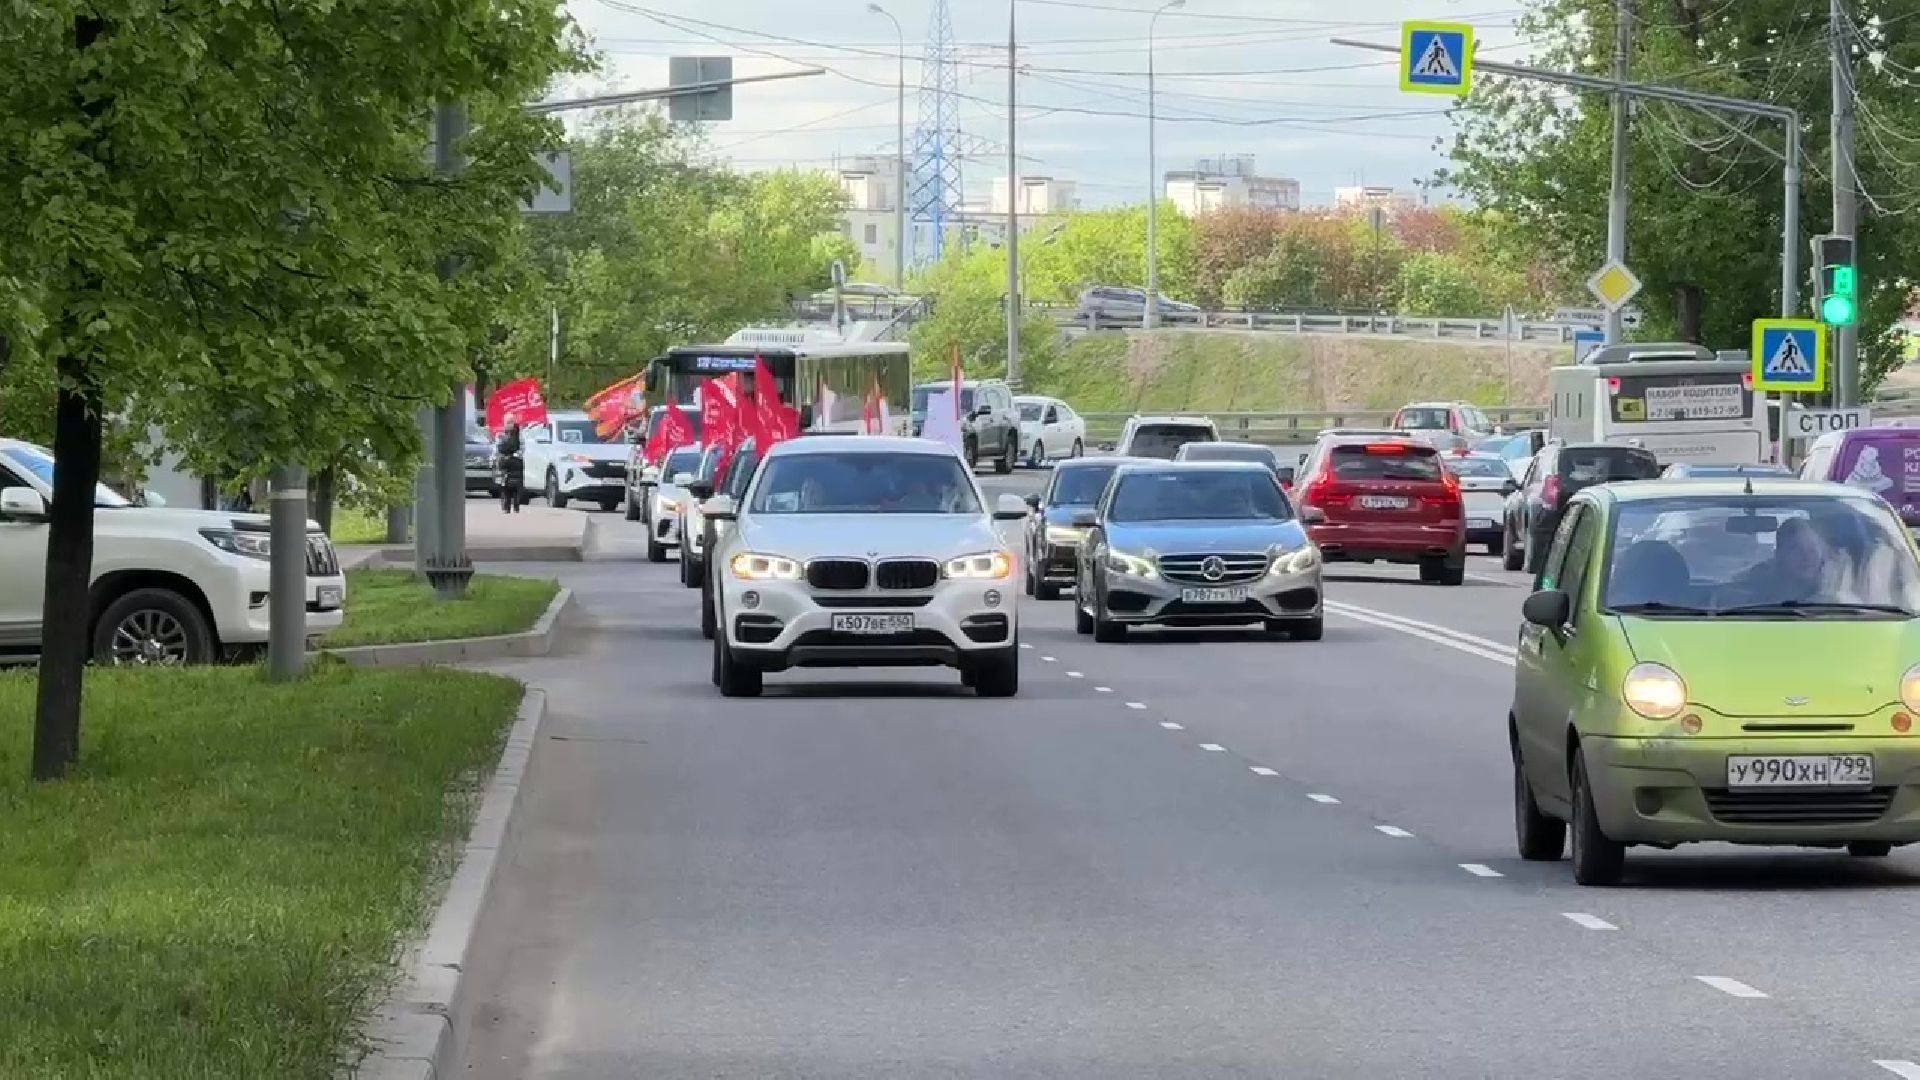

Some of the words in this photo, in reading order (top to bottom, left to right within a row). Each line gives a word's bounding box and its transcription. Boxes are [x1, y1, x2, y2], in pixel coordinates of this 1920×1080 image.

[1648, 388, 1681, 400] НАБОР
[1683, 387, 1739, 398] ВОДИТЕЛЕЙ
[1799, 413, 1859, 432] СТОП
[1736, 758, 1827, 783] У990ХН
[1831, 756, 1867, 775] 799
